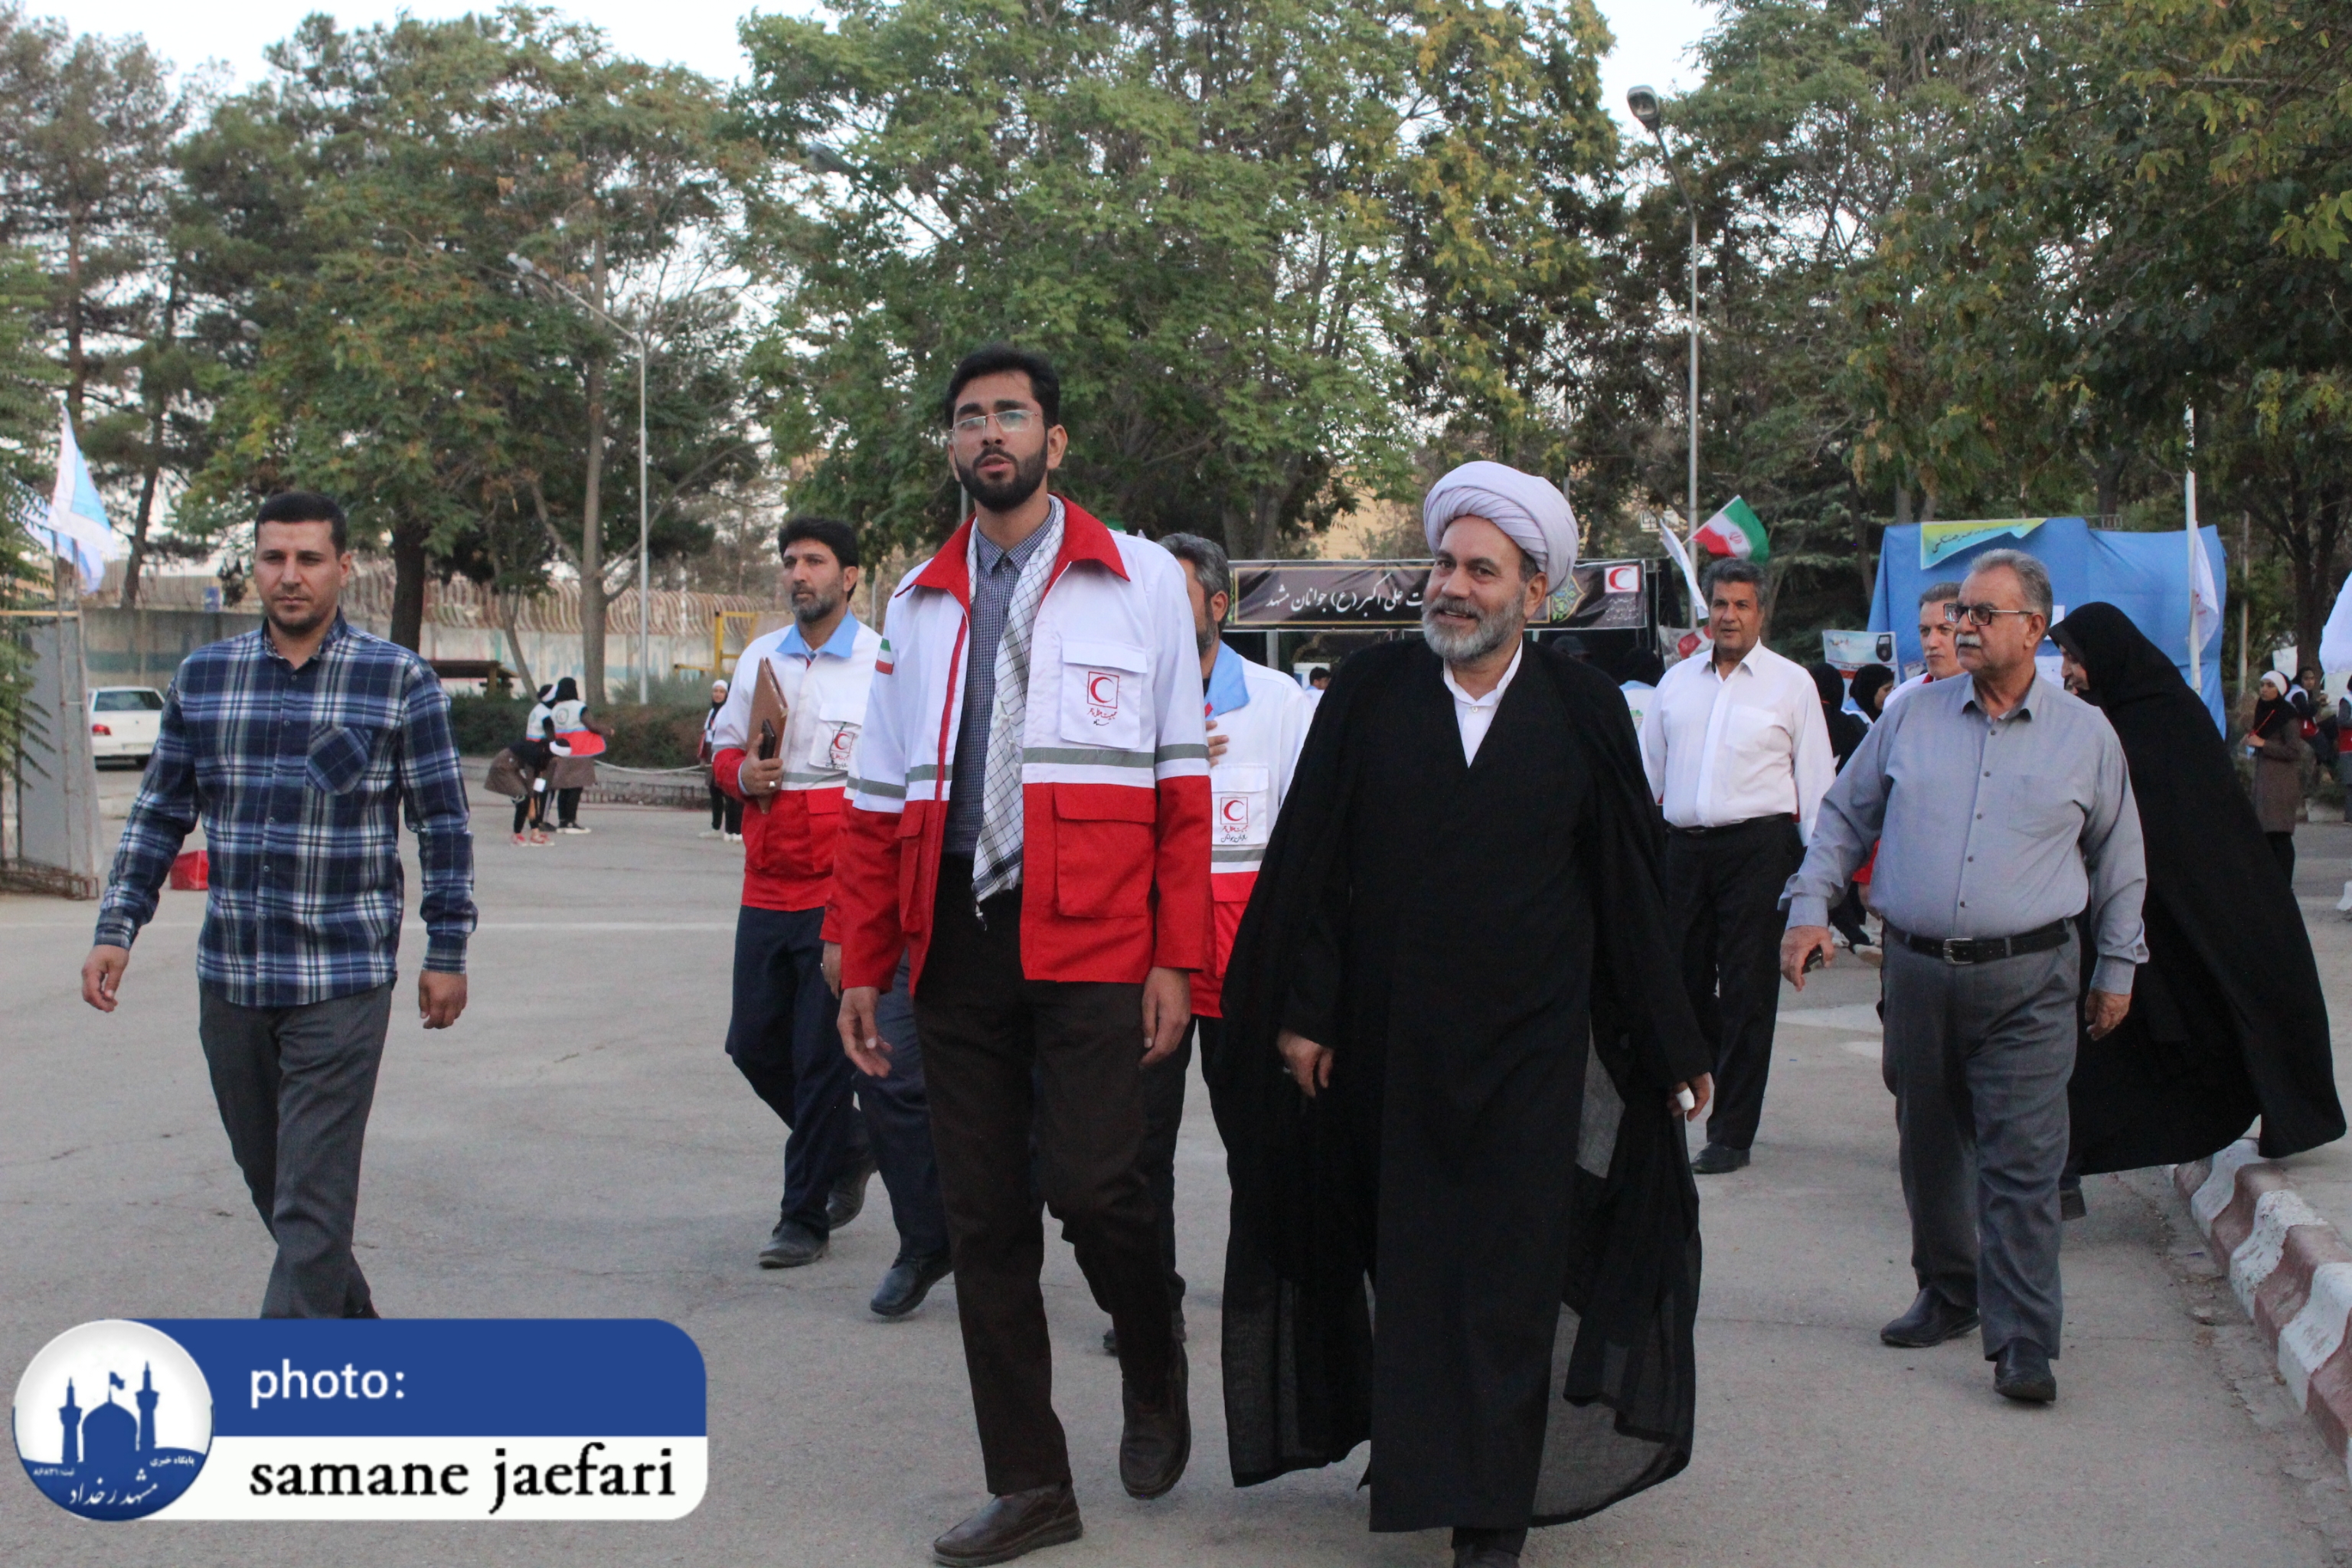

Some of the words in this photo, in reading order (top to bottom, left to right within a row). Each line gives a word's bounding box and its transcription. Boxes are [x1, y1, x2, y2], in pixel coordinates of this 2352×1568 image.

[1266, 583, 1290, 607] مشهد
[1290, 586, 1328, 613] جوانان
[1355, 572, 1392, 617] اکبر
[1383, 587, 1404, 611] علی
